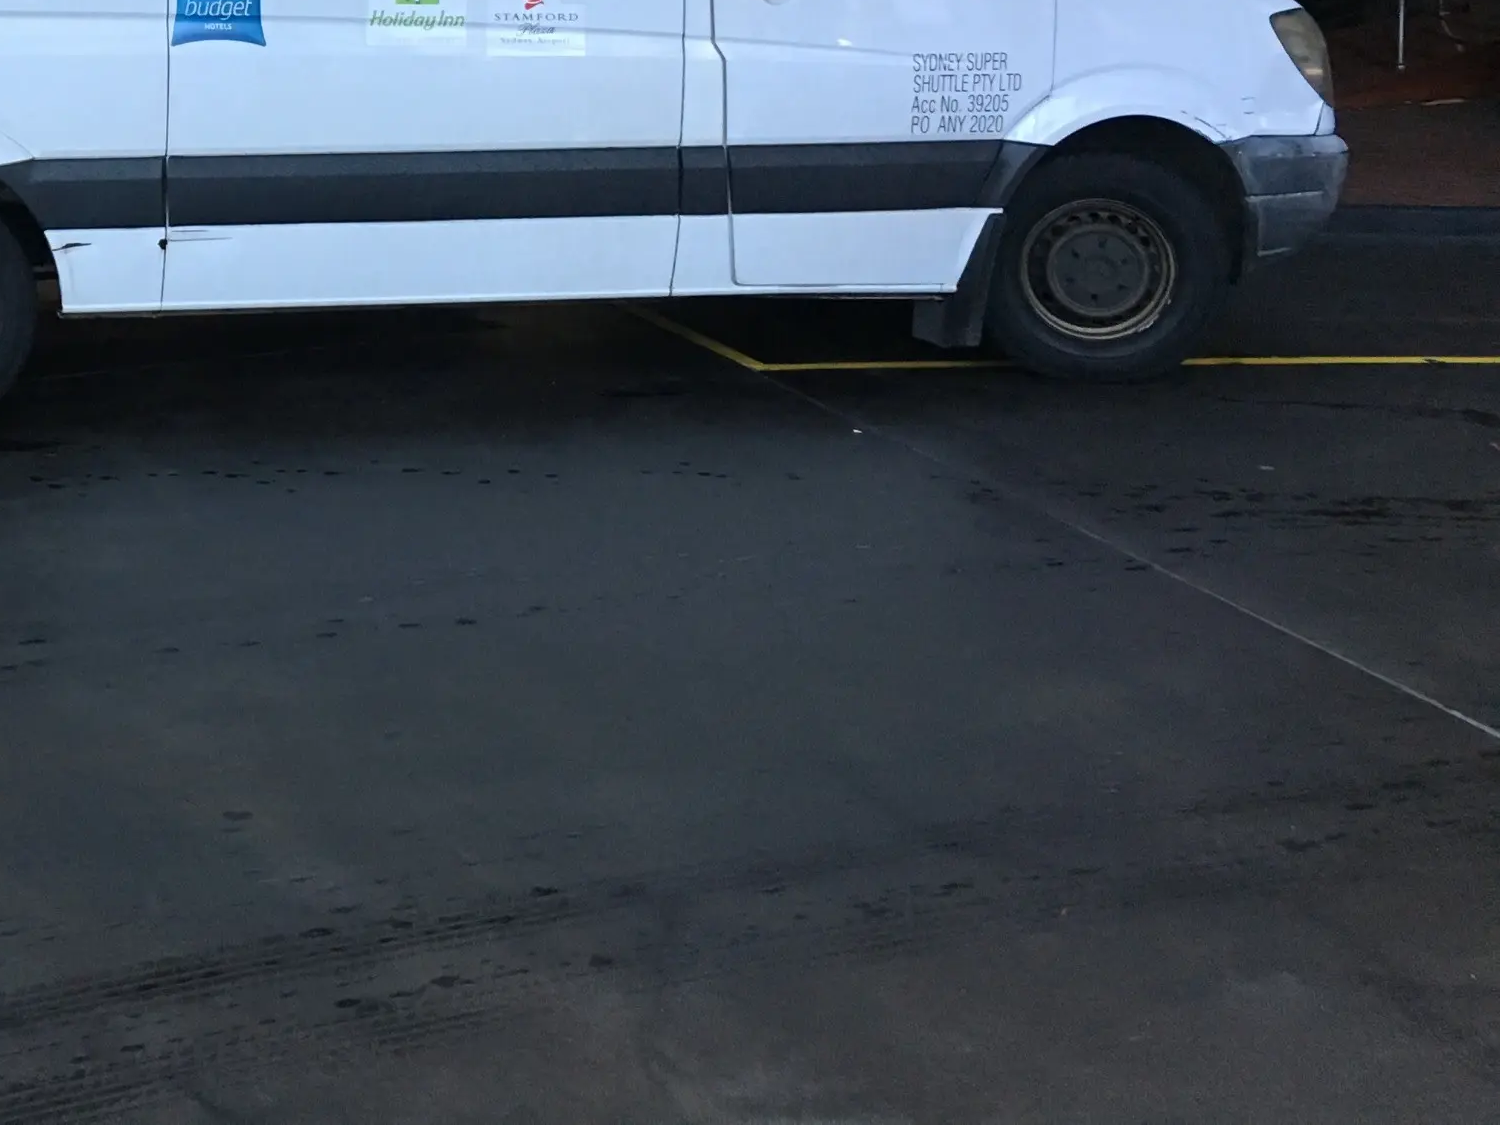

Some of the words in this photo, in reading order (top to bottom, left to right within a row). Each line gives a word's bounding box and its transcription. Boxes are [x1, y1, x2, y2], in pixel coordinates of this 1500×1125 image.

[204, 22, 233, 31] HOTELS
[494, 12, 579, 22] STAMFORD
[912, 53, 963, 72] SYDNEY
[966, 52, 1008, 71] SUPER
[913, 74, 969, 93] SHUTTLE
[973, 74, 996, 92] PTY
[999, 73, 1022, 92] LTD
[911, 96, 936, 114] Acc
[967, 94, 1009, 112] 39205
[969, 115, 1004, 133] 2020
